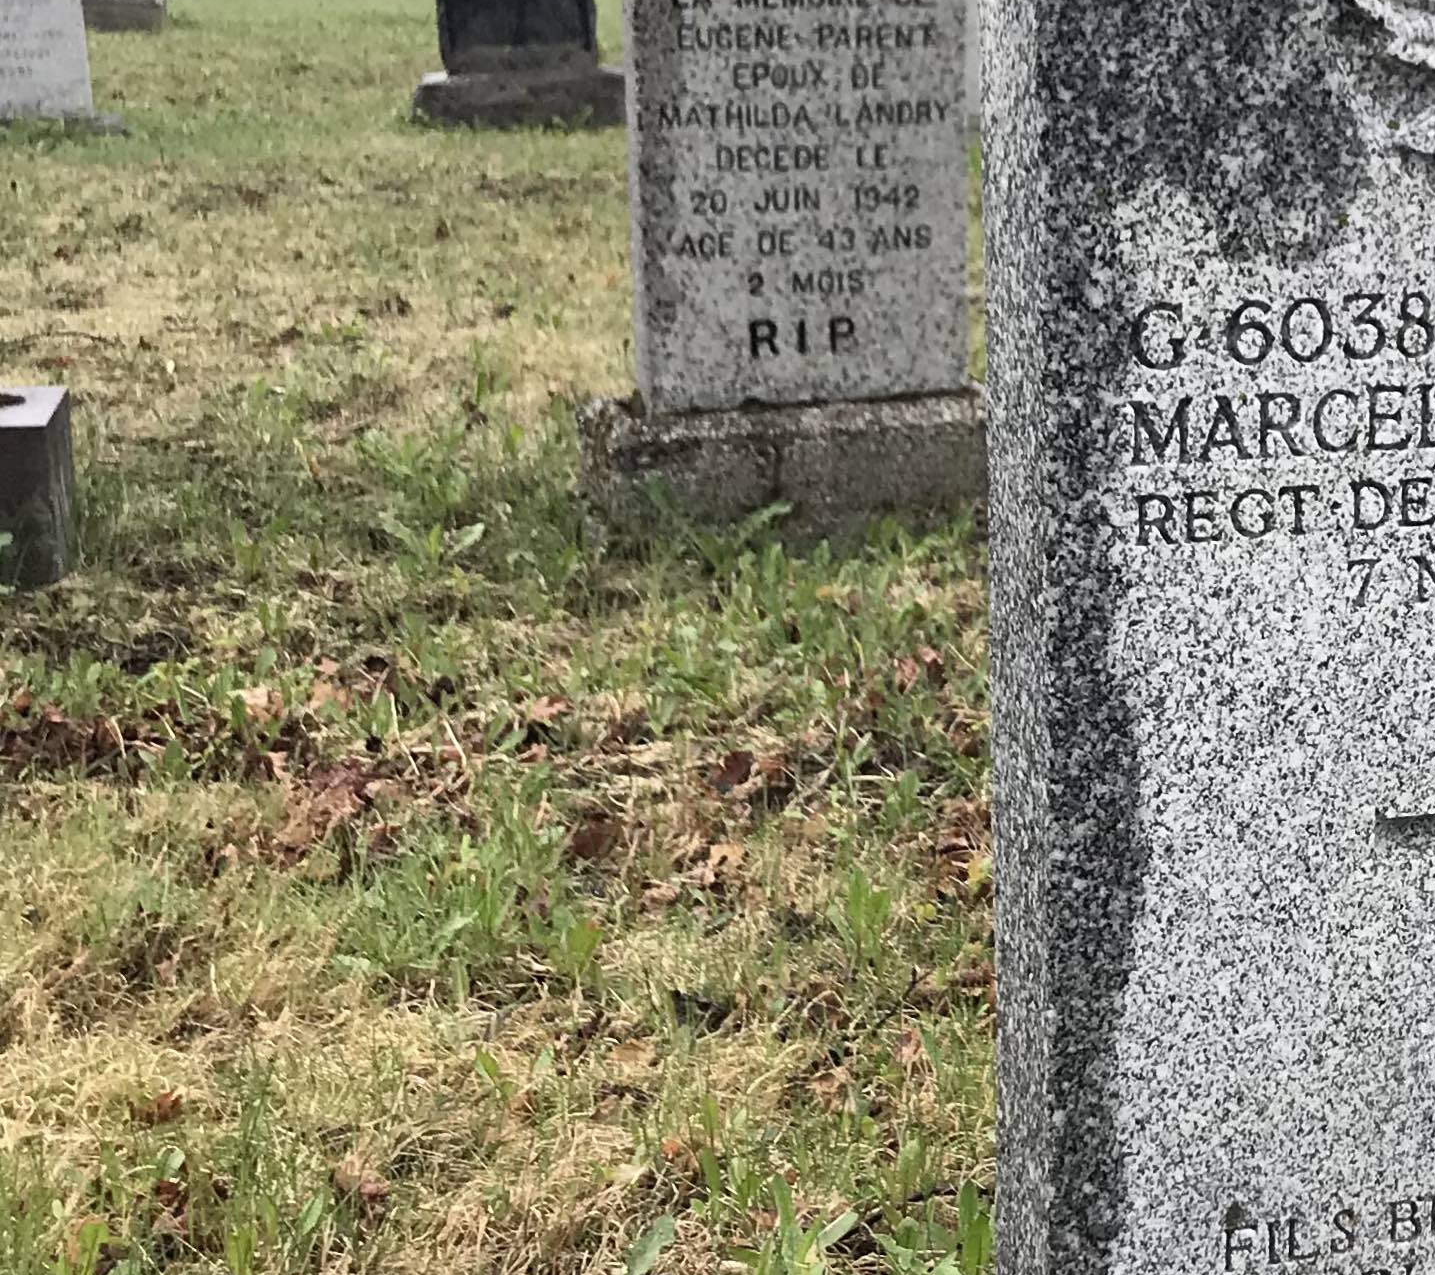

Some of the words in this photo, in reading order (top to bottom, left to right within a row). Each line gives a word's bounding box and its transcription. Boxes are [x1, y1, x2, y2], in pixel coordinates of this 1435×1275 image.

[676, 25, 794, 51] EUGENE
[815, 23, 938, 50] PARENT
[732, 62, 829, 91] EPOUX
[850, 62, 888, 90] DE
[657, 103, 813, 130] MATHILDA
[835, 100, 951, 126] LANDRY
[716, 144, 830, 173] DECEDE
[856, 144, 891, 170] LE
[689, 188, 729, 217] 20
[753, 187, 822, 214] JUIN
[853, 185, 922, 213] 1942
[677, 232, 735, 262] AGE
[756, 229, 796, 257] DE
[817, 226, 857, 255] 43
[868, 224, 933, 255] ANS
[746, 271, 765, 298] 2
[791, 269, 866, 296] MOIS
[1346, 558, 1382, 608] 7
[1222, 1208, 1356, 1272] FILS
